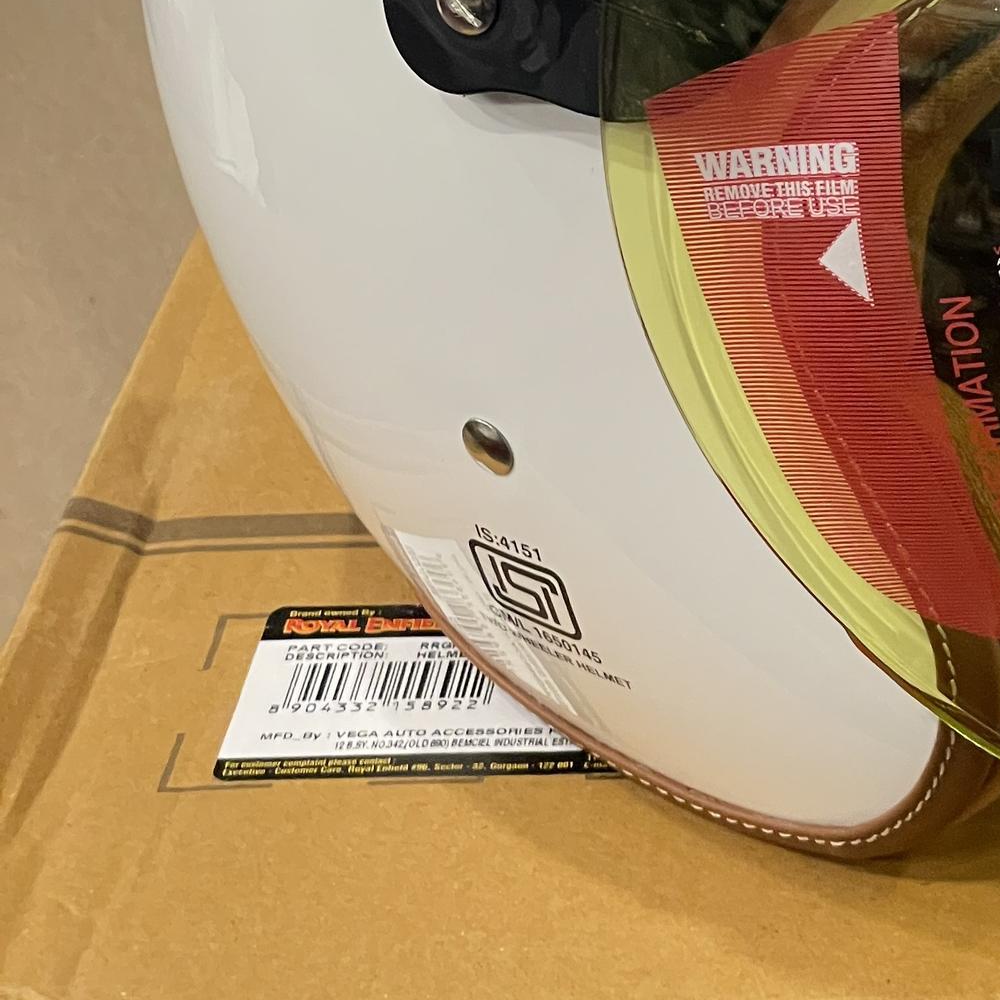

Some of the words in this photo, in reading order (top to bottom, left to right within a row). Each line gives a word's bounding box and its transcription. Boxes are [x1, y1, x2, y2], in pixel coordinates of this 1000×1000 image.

[695, 142, 859, 181] WARNING
[704, 183, 771, 200] REMOVE
[777, 180, 811, 197] THIS
[816, 179, 858, 196] FILM
[707, 198, 804, 219] BEFORE
[809, 195, 859, 217] USE
[939, 296, 1000, 424] MATION
[475, 524, 542, 562] IS:4151
[290, 610, 322, 618] Brand
[324, 609, 359, 617] owned
[283, 618, 361, 635] ROYAL
[364, 617, 441, 633] ENFIE
[288, 644, 331, 652] PART
[533, 626, 602, 664] 1650145
[576, 660, 632, 690] HELMET
[336, 730, 378, 738] VEGA
[384, 729, 427, 737] AUTO
[431, 728, 544, 737] ACCESSORIES
[494, 737, 548, 746] INDUSTRIAL
